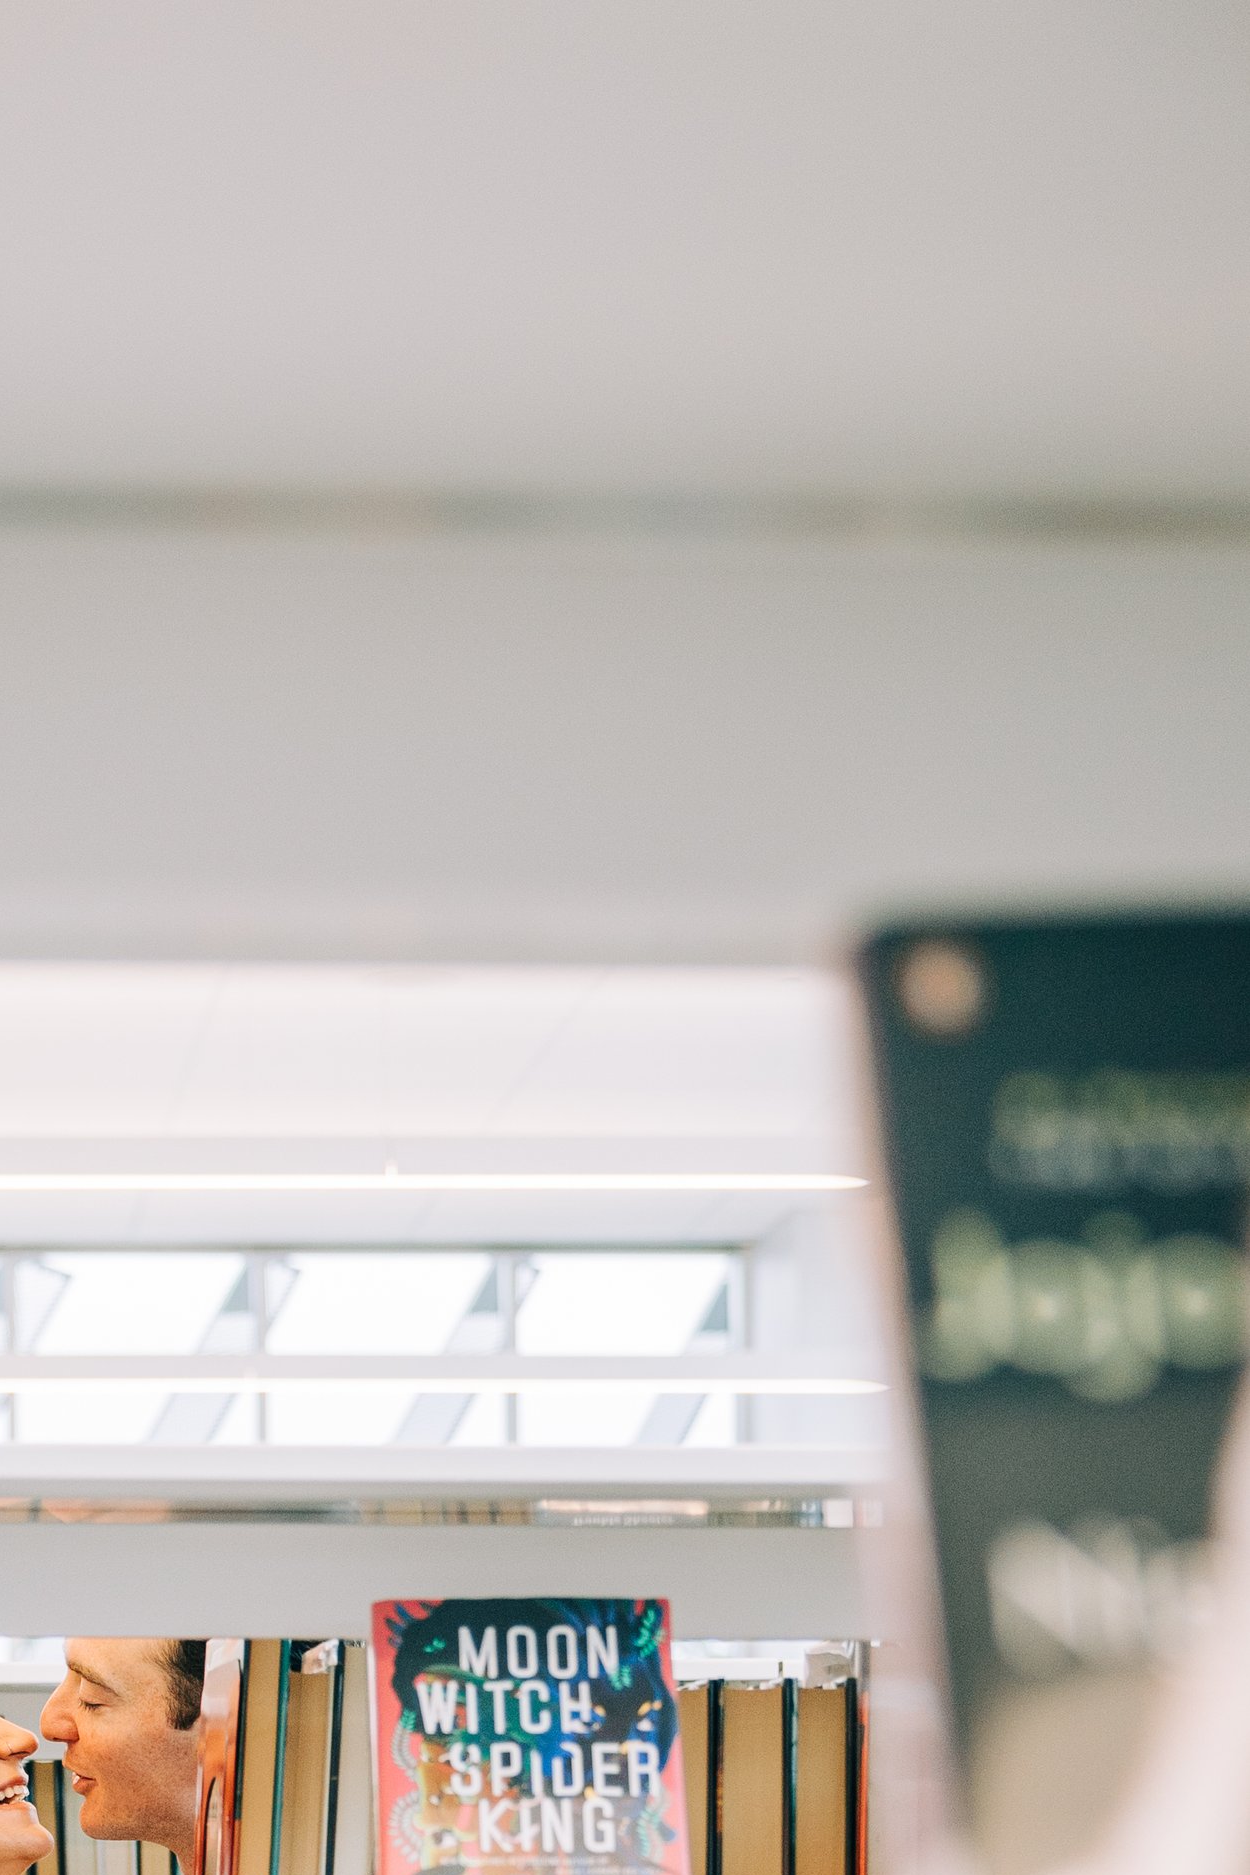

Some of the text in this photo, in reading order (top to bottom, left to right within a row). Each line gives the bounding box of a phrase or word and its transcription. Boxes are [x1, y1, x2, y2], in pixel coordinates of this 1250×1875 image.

[458, 1625, 620, 1680] MOON
[415, 1680, 592, 1735] WITCH
[448, 1741, 661, 1798] SPIDER
[479, 1799, 616, 1854] KING
